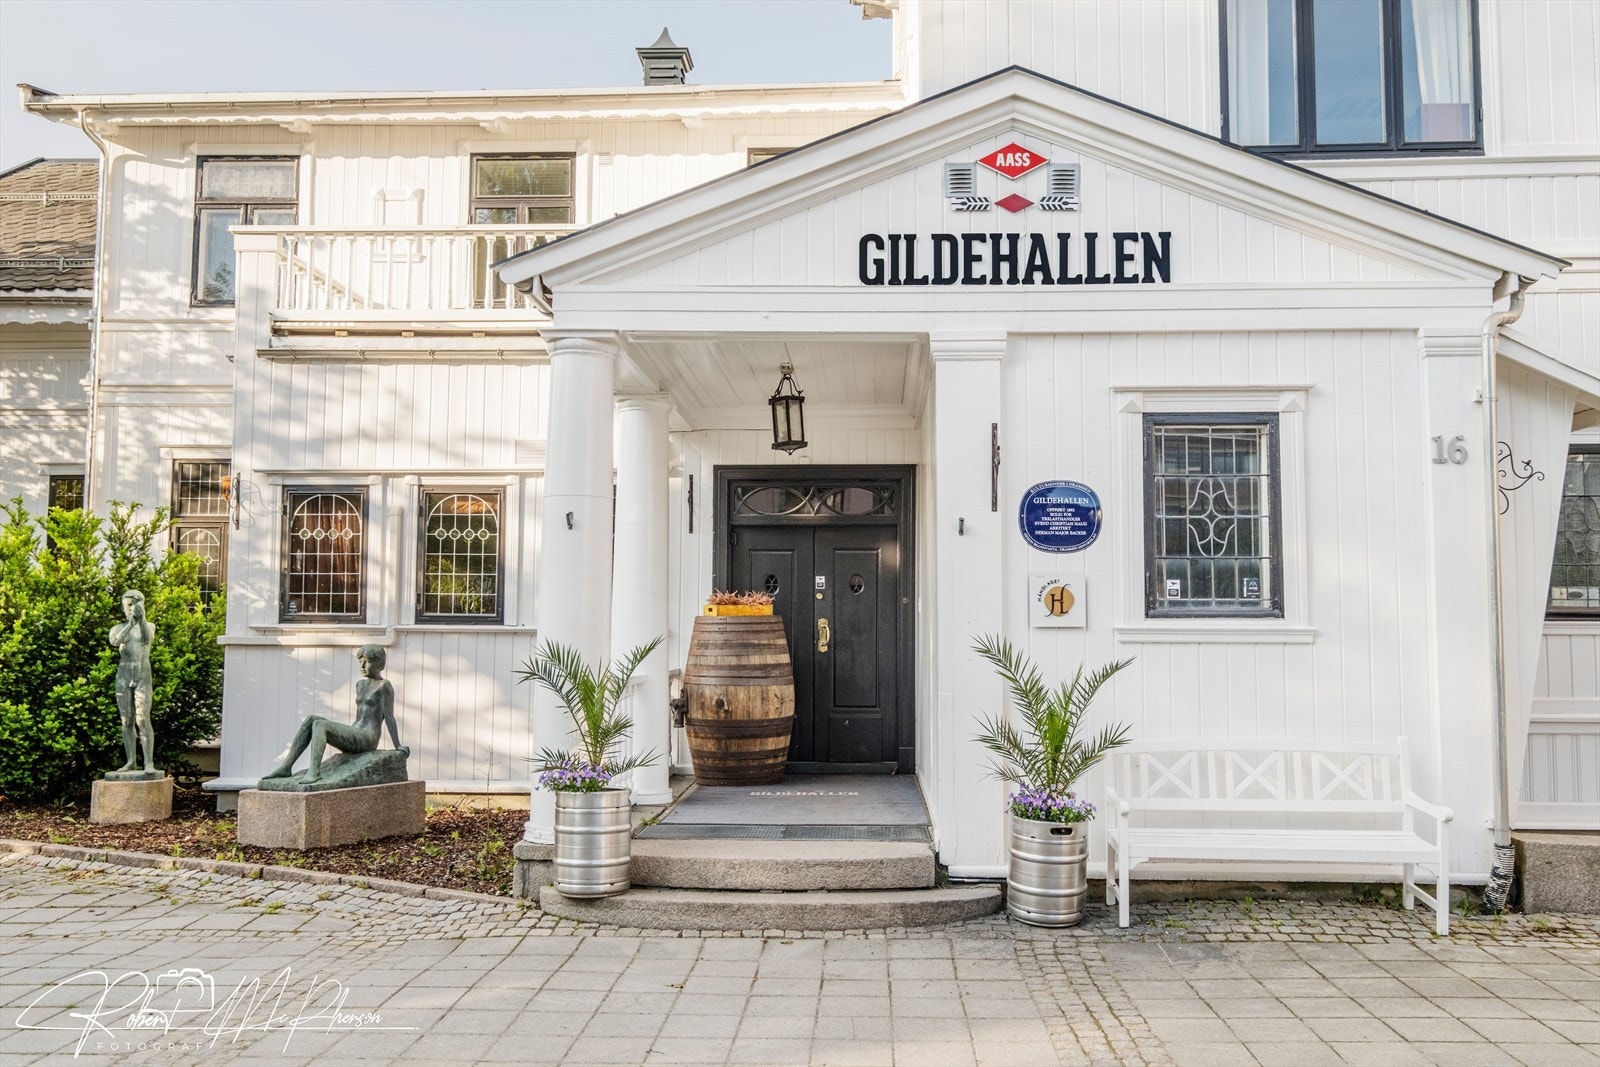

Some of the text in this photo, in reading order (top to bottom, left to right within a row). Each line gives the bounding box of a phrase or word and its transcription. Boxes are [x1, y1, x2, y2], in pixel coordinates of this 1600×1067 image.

[996, 153, 1030, 167] AASS
[858, 231, 1172, 285] GILDEHALLEN
[1431, 435, 1468, 464] 16
